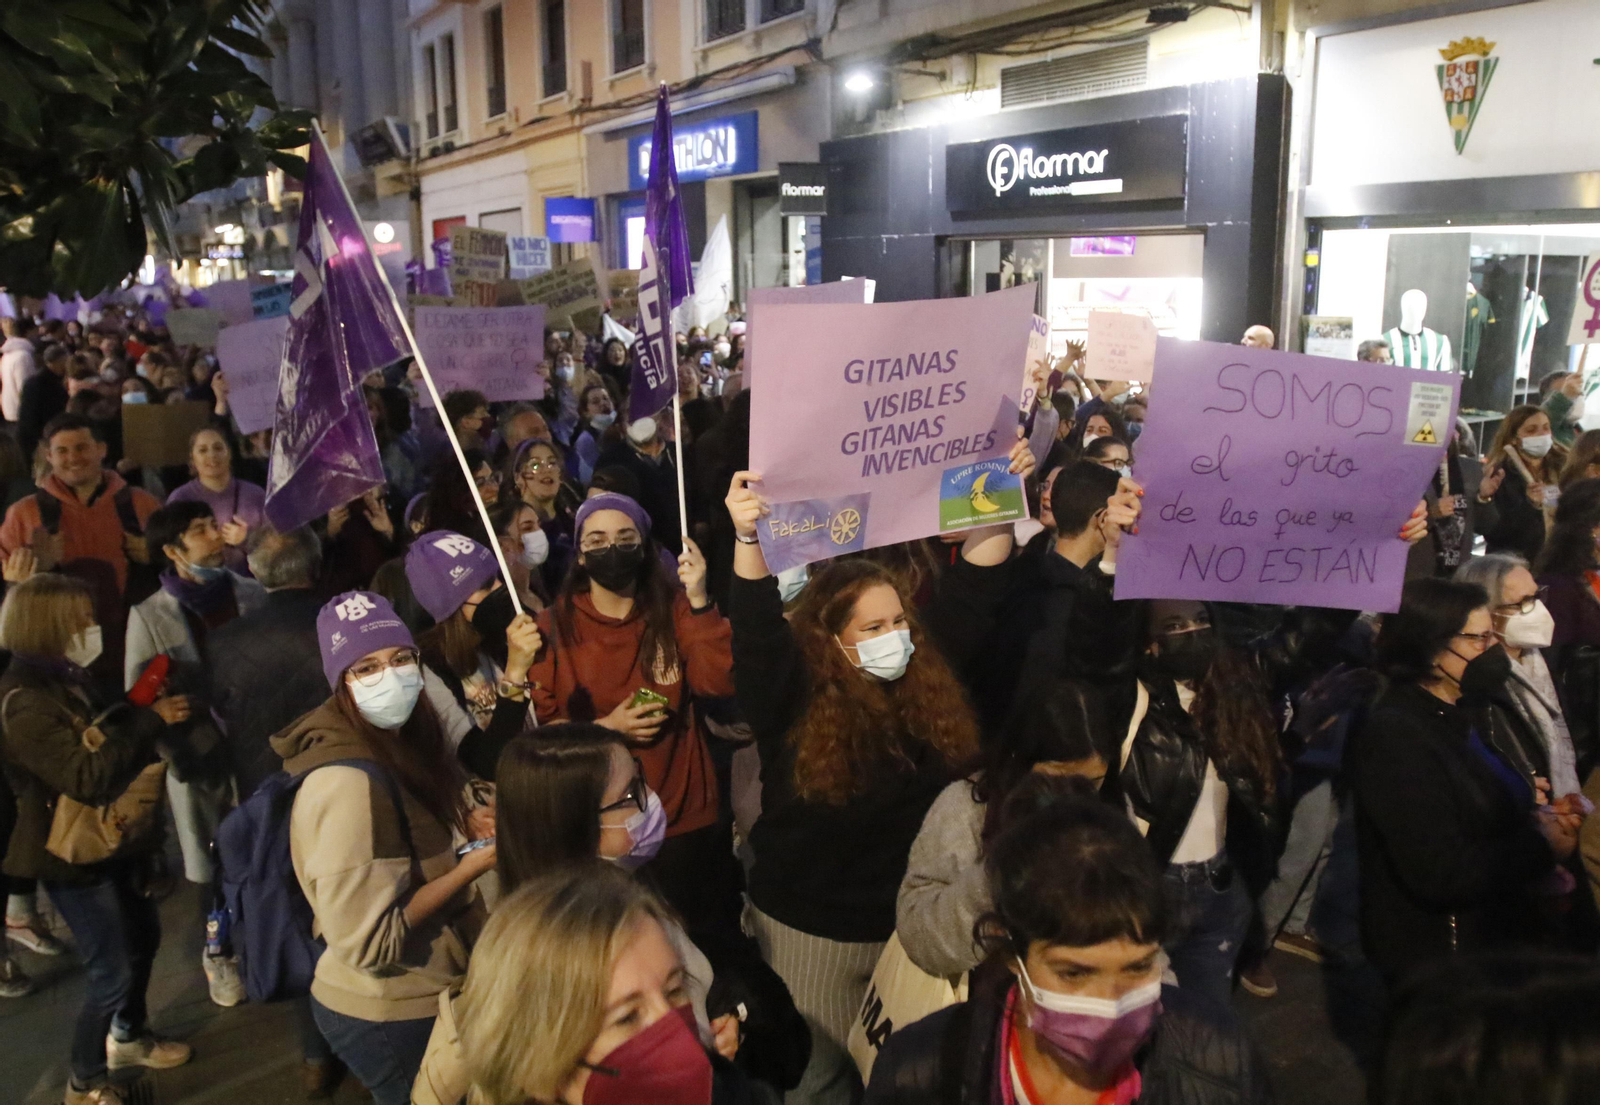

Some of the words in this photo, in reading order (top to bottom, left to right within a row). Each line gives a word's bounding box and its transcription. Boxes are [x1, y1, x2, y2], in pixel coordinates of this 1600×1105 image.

[1019, 147, 1109, 180] flormar
[781, 183, 825, 197] flormar
[844, 349, 958, 384] GITANAS
[863, 381, 967, 422] VISIBLES
[1203, 363, 1394, 439] SOMOS
[841, 415, 946, 456] GITANAS
[861, 430, 997, 478] INVENCIBLES
[950, 466, 974, 485] UPRE
[1190, 435, 1231, 481] el
[1281, 446, 1360, 486] grito
[1159, 491, 1197, 523] de
[1220, 498, 1258, 527] las
[1274, 508, 1316, 540] que
[1331, 510, 1354, 533] ya
[1179, 544, 1246, 583] NO
[1259, 538, 1378, 584] ESTÁN
